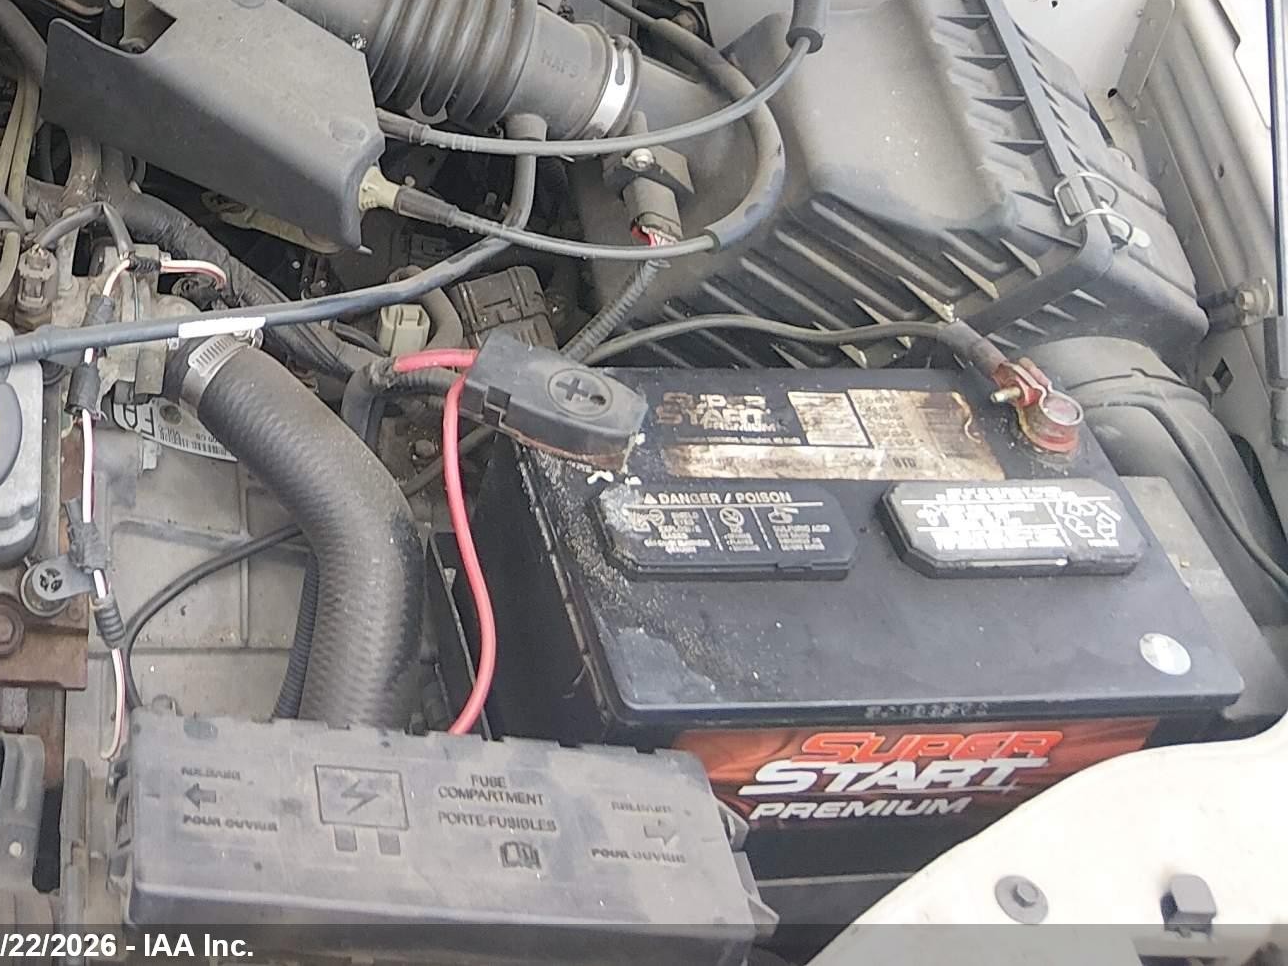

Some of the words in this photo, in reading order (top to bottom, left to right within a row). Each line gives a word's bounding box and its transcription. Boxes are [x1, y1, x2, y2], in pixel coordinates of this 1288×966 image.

[658, 492, 722, 505] DANGER
[735, 491, 793, 504] POISON
[790, 731, 1064, 763] SUPER
[470, 773, 507, 789] FUSE
[738, 756, 1050, 795] START
[438, 785, 544, 806] COMPARTMENT
[748, 797, 972, 821] PREMIUM
[183, 814, 222, 828] POUR
[591, 847, 630, 860] POUR
